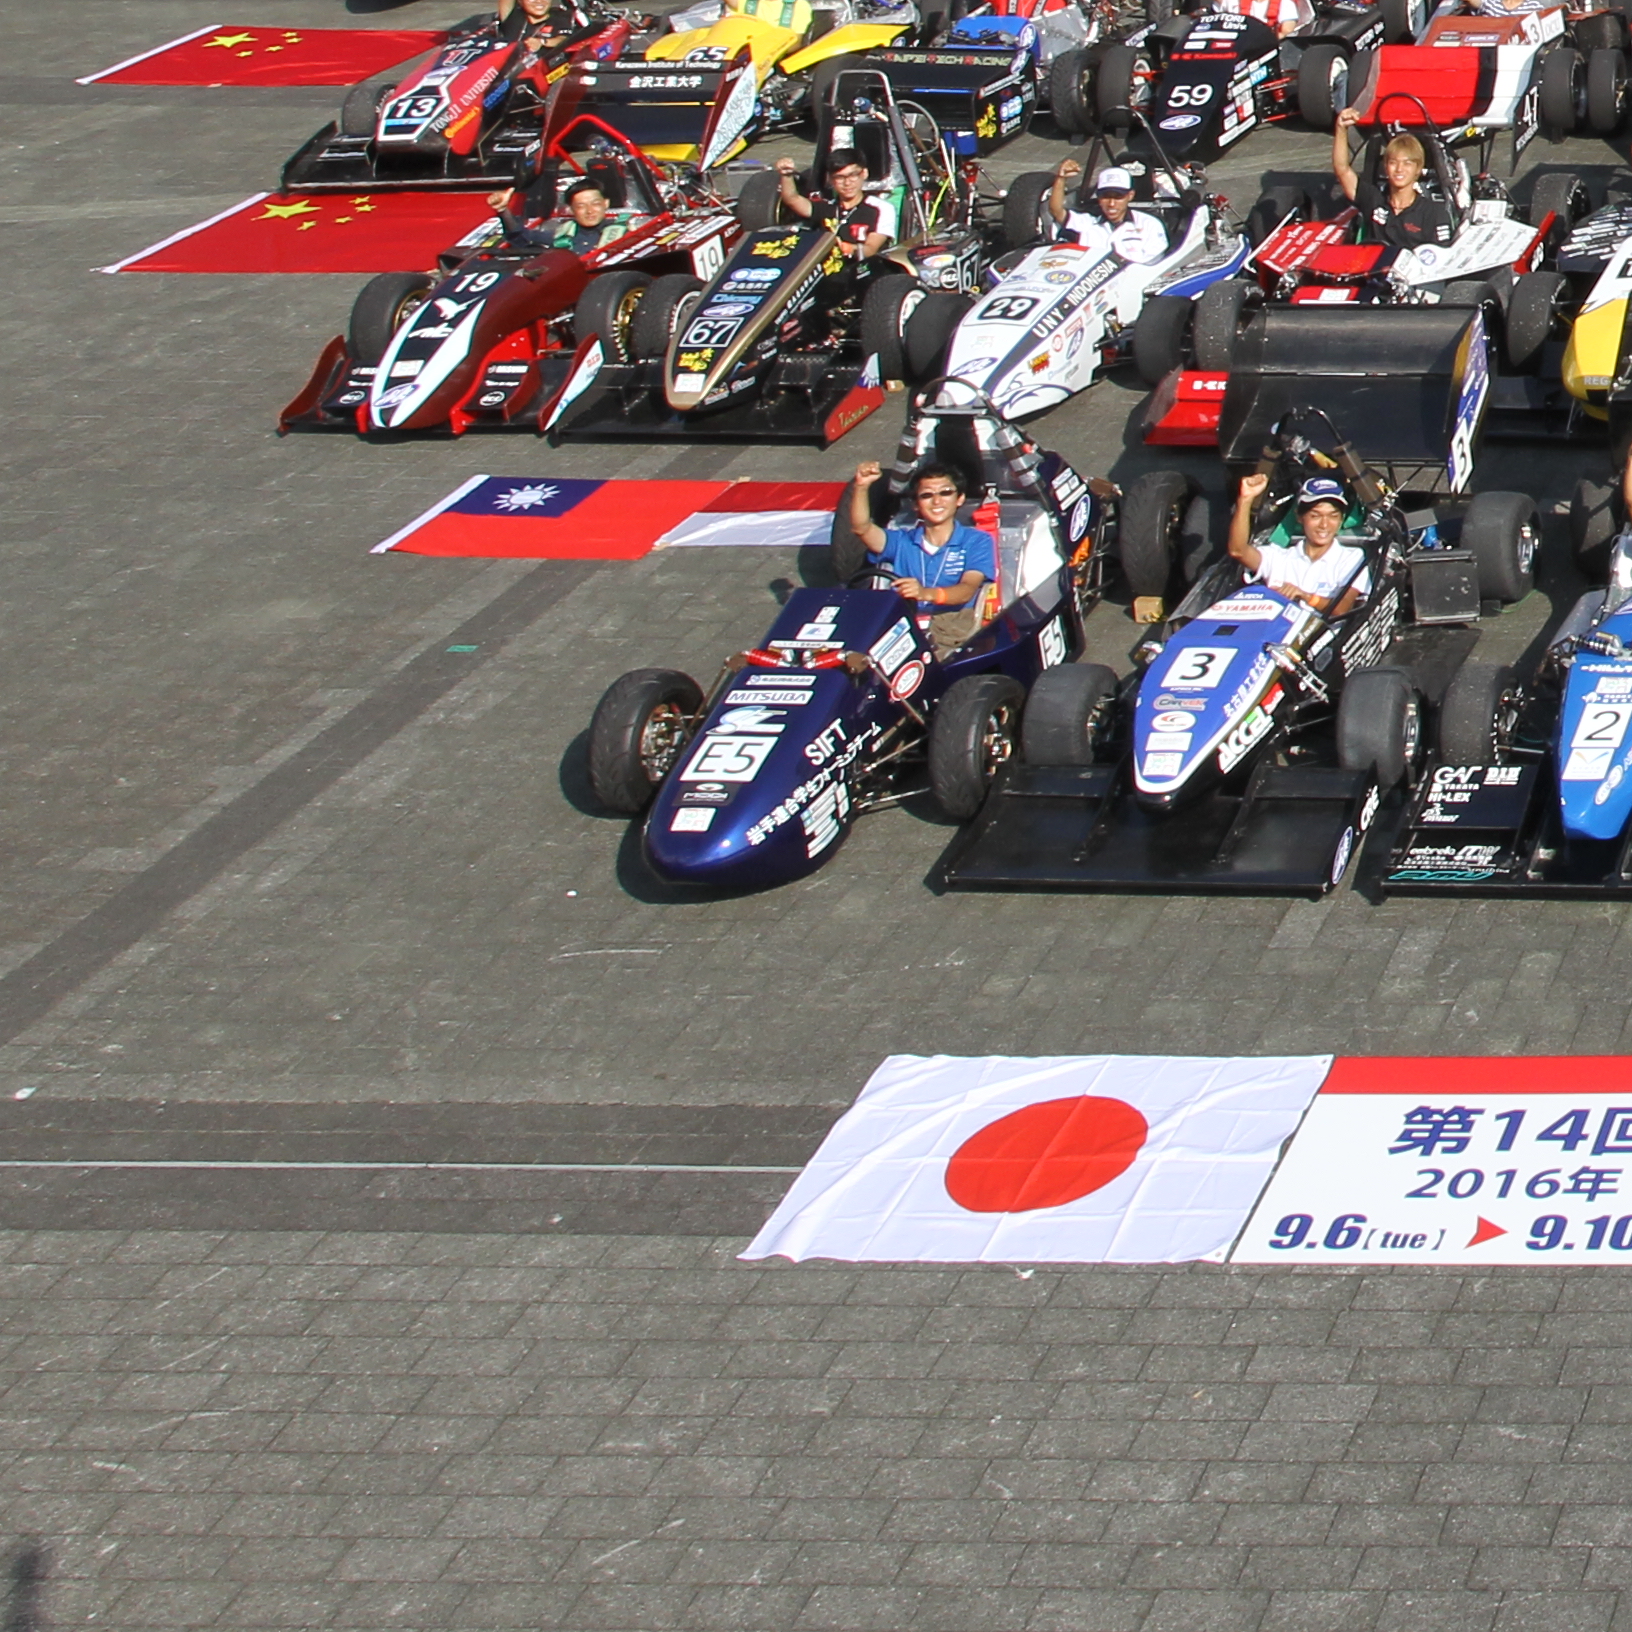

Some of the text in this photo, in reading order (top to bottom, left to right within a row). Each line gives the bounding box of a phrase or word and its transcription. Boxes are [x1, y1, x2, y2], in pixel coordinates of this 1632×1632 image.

[1199, 13, 1246, 24] TOTTORI
[615, 60, 647, 69] Kanazawa
[646, 60, 676, 69] Institute
[685, 60, 722, 71] Technology
[686, 46, 729, 61] 65
[629, 75, 704, 90] 金沢工業大学
[395, 98, 438, 118] 13
[1167, 84, 1214, 108] 59
[697, 243, 721, 280] 19
[962, 254, 980, 286] 67
[454, 271, 502, 294] 19
[989, 297, 1034, 318] 29
[1032, 257, 1119, 339] UNY INDONESIA
[687, 320, 731, 344] 67
[1226, 603, 1274, 613] YAMAHA
[1041, 624, 1066, 660] E5
[1178, 651, 1218, 681] 3
[727, 691, 809, 703] MITSUBA
[1583, 709, 1622, 742] 2
[804, 718, 849, 767] SIFT
[1218, 706, 1273, 775] ACCEL
[693, 740, 766, 775] E5
[1427, 792, 1472, 803] HI-LEX
[1404, 1166, 1624, 1202] 2016年
